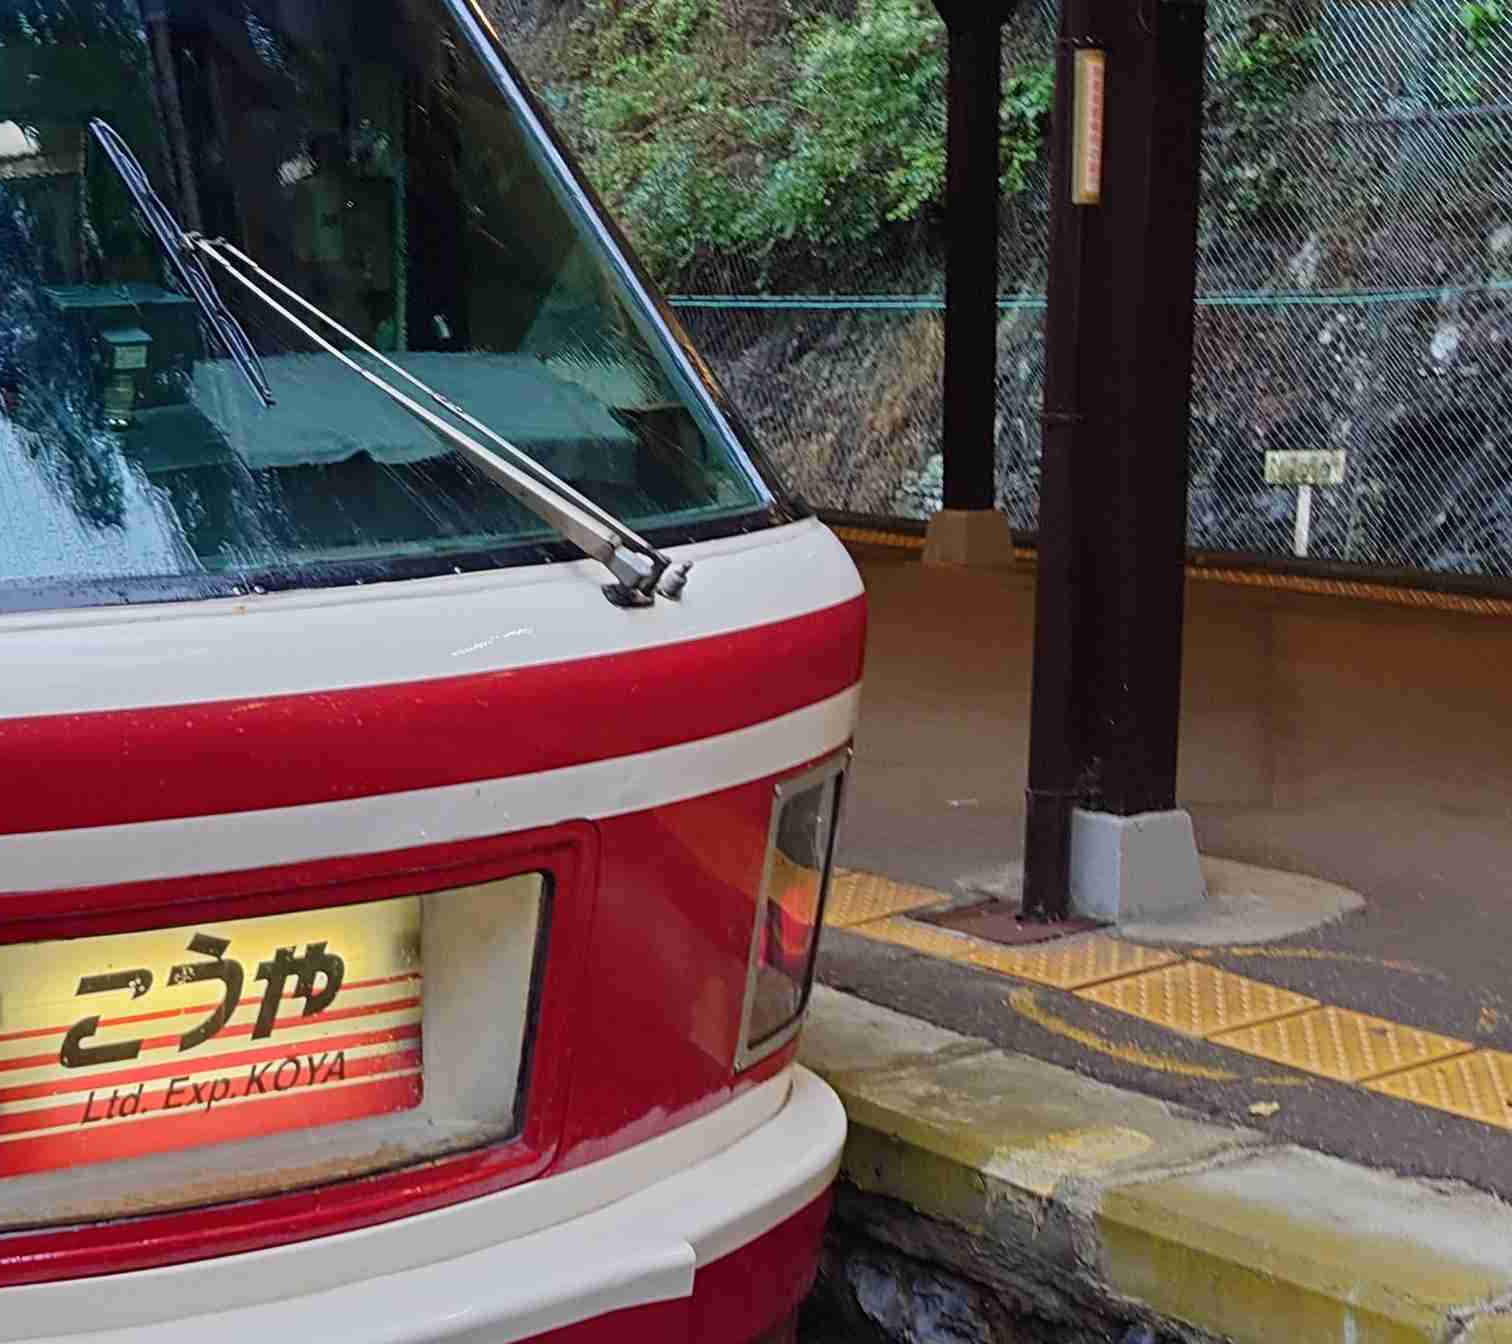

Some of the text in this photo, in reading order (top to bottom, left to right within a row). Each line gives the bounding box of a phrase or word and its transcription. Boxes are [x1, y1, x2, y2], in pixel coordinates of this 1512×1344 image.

[60, 933, 345, 1068] こうや
[80, 1050, 347, 1124] Ltd. Exp. KOYA
